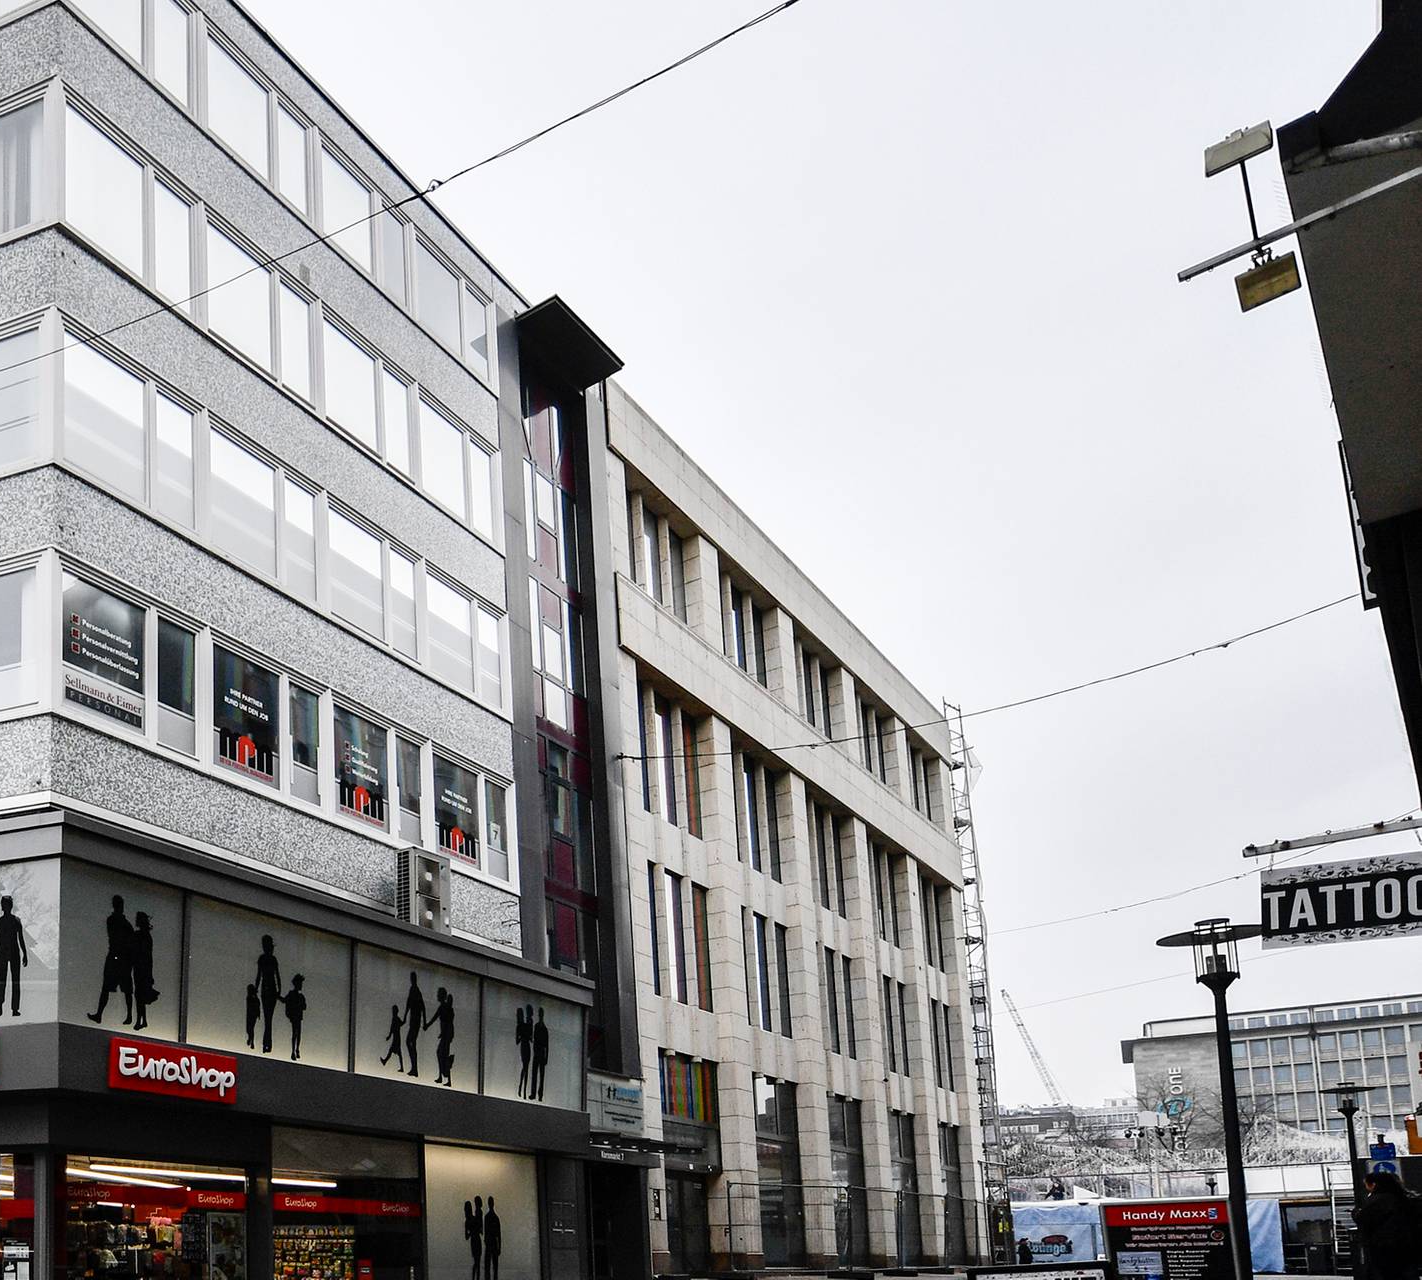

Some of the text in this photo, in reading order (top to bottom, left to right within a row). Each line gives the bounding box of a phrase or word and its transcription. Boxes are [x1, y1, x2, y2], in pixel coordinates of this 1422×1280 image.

[65, 674, 142, 714] Sellmann & Eimer
[117, 1046, 236, 1095] EuroShop
[198, 1194, 234, 1206] EuroShop
[285, 1197, 317, 1209] EuroShop
[1122, 1210, 1166, 1221] Handy
